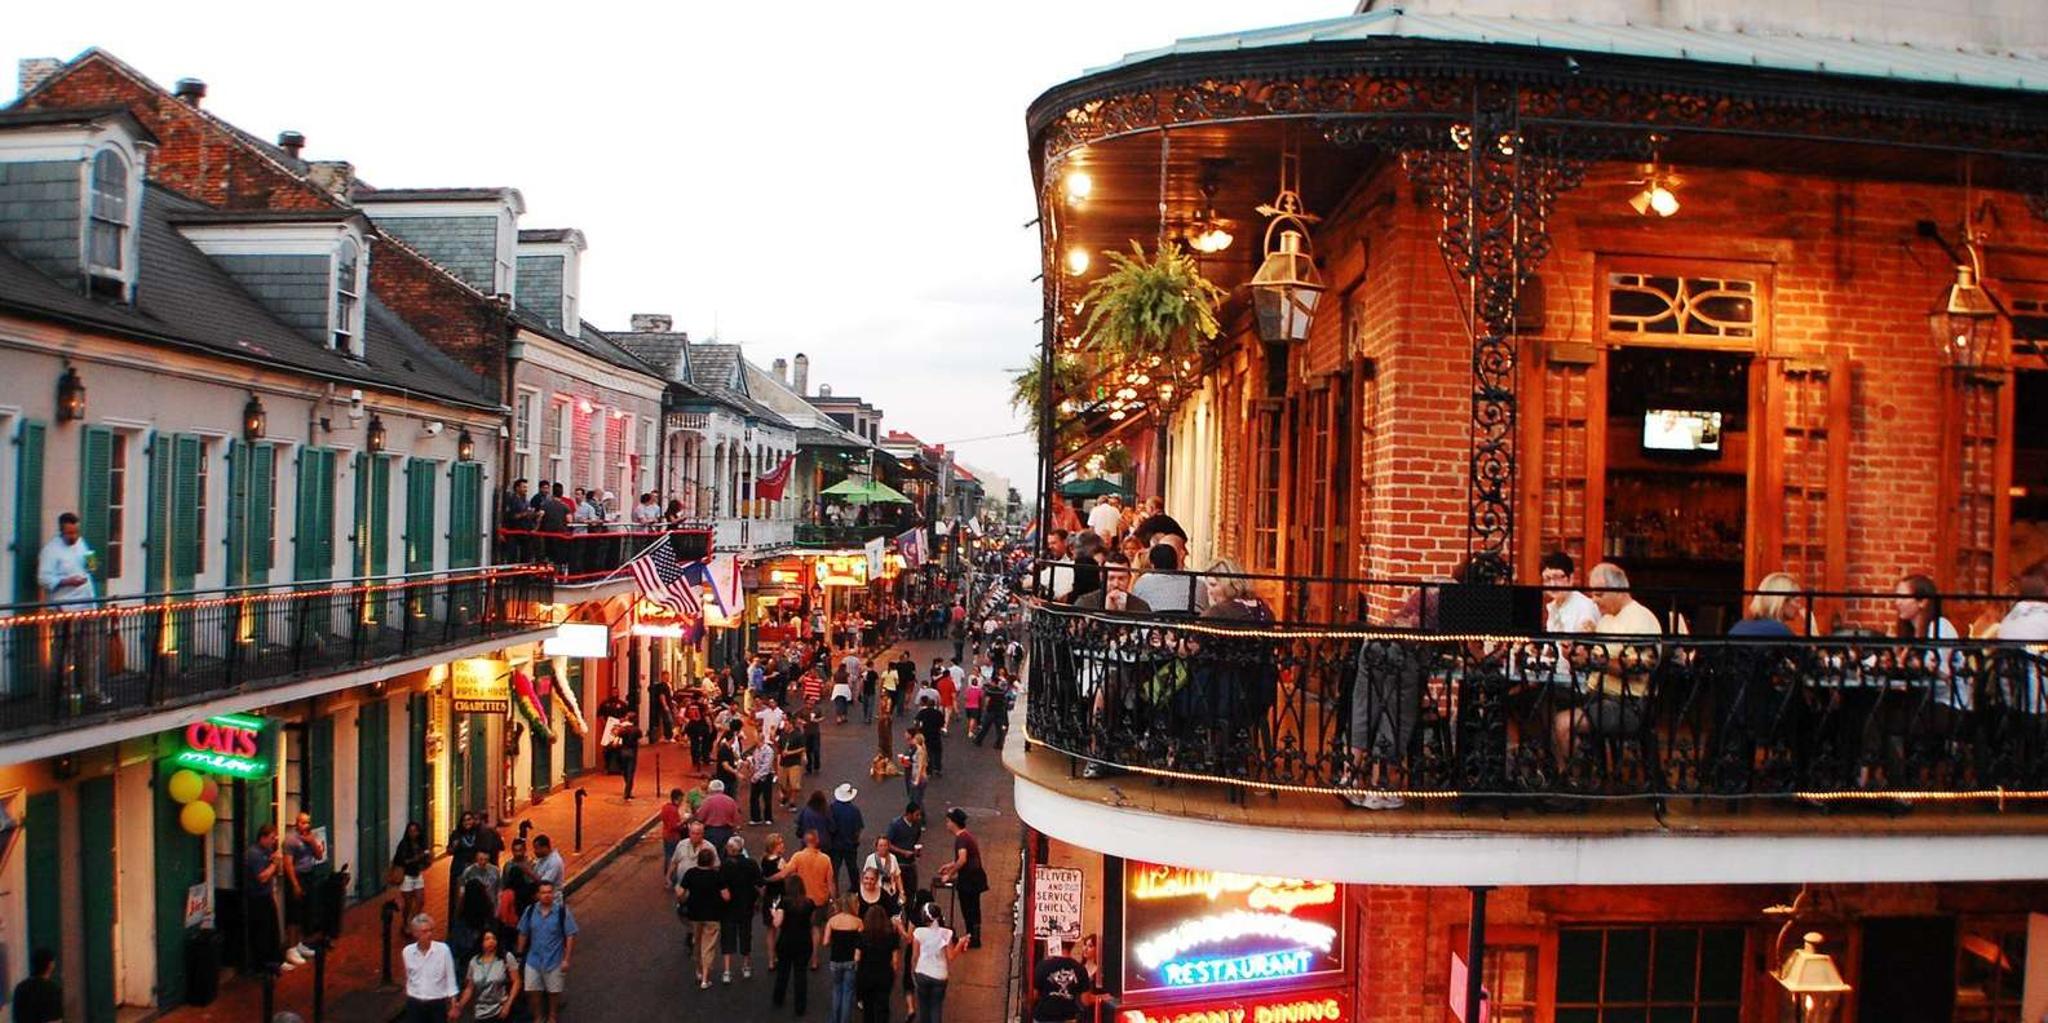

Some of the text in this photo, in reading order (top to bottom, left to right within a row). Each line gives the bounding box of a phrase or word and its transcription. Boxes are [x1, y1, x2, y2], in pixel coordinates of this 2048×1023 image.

[455, 701, 507, 712] CIGARETTES
[1048, 883, 1063, 891] AND
[1036, 891, 1074, 903] SERVICE
[1035, 902, 1079, 913] EHICLS
[1042, 914, 1067, 924] ONY
[1164, 951, 1313, 986] RESTAURANT
[1253, 998, 1341, 1023] DINING
